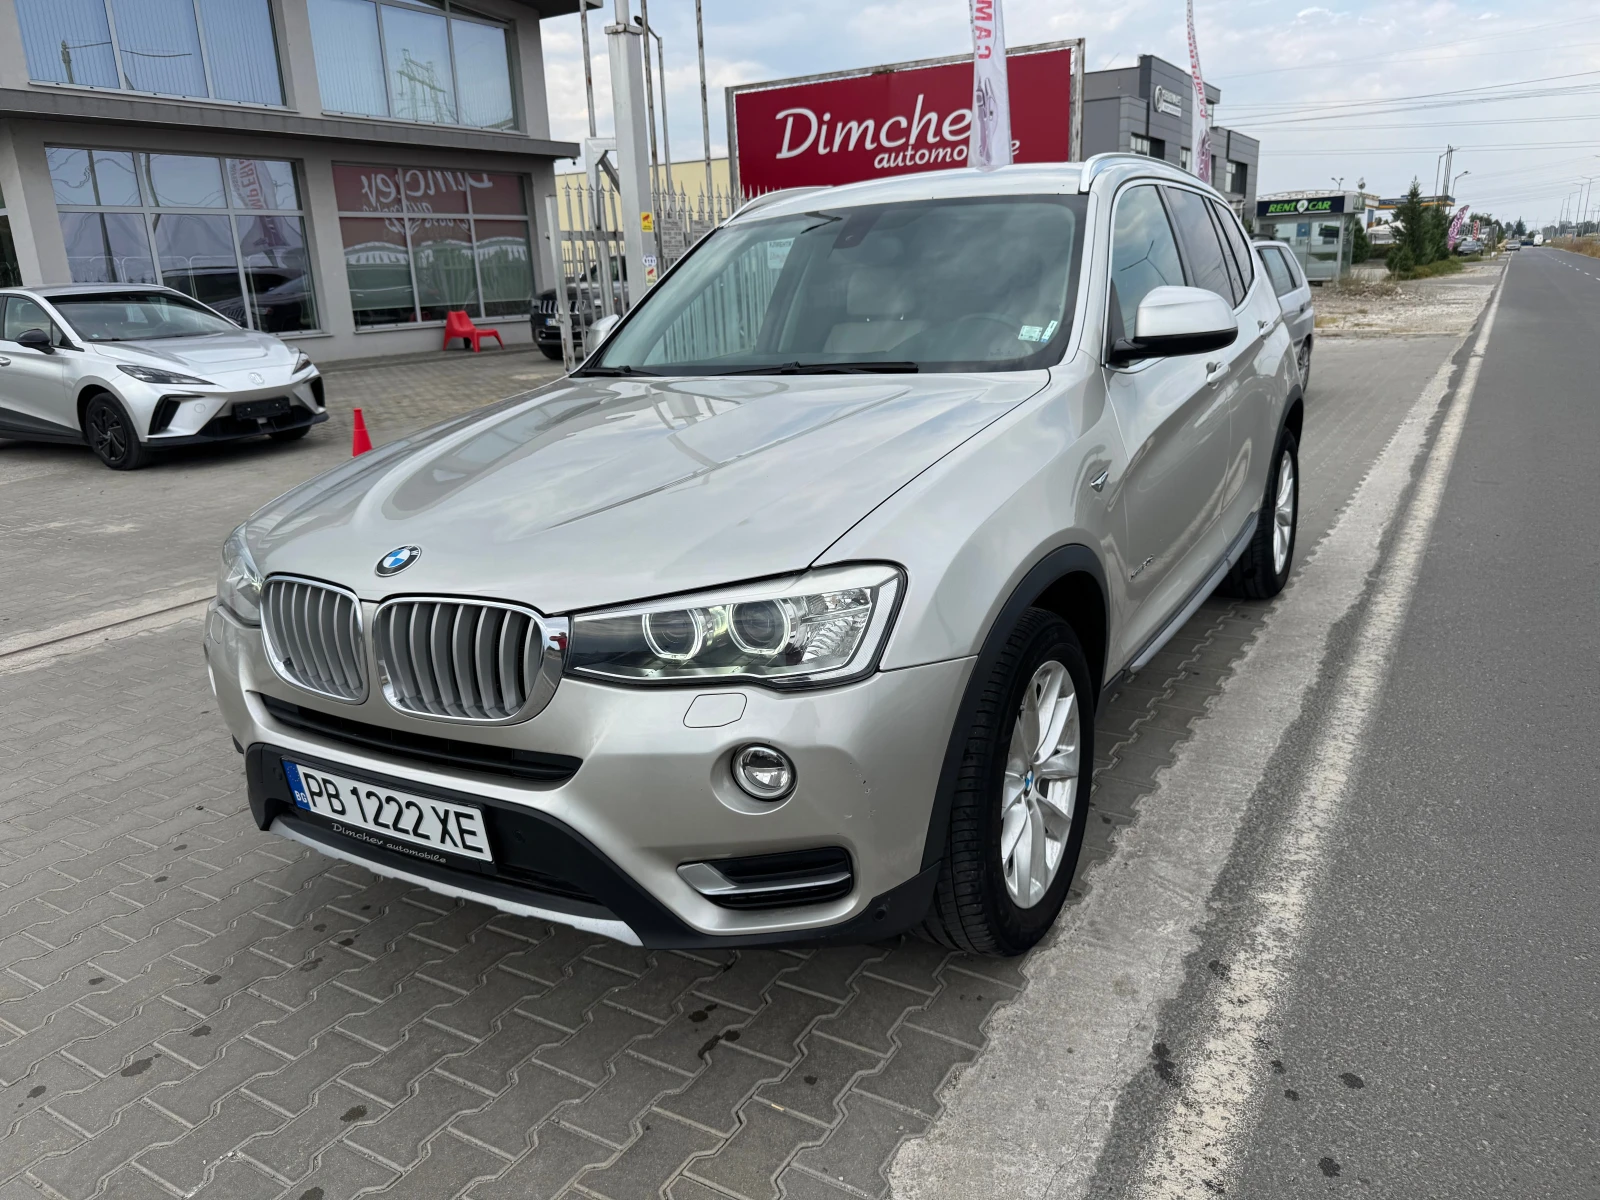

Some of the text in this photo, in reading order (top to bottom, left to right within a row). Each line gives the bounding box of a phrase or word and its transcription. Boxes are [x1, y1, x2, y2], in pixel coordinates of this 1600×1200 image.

[775, 94, 972, 159] Dimche
[874, 139, 1020, 169] automoe
[1308, 201, 1332, 210] CAR
[294, 790, 308, 803] BG
[303, 771, 484, 854] PB 1222 XE
[331, 822, 447, 864] Dimchev automobile
